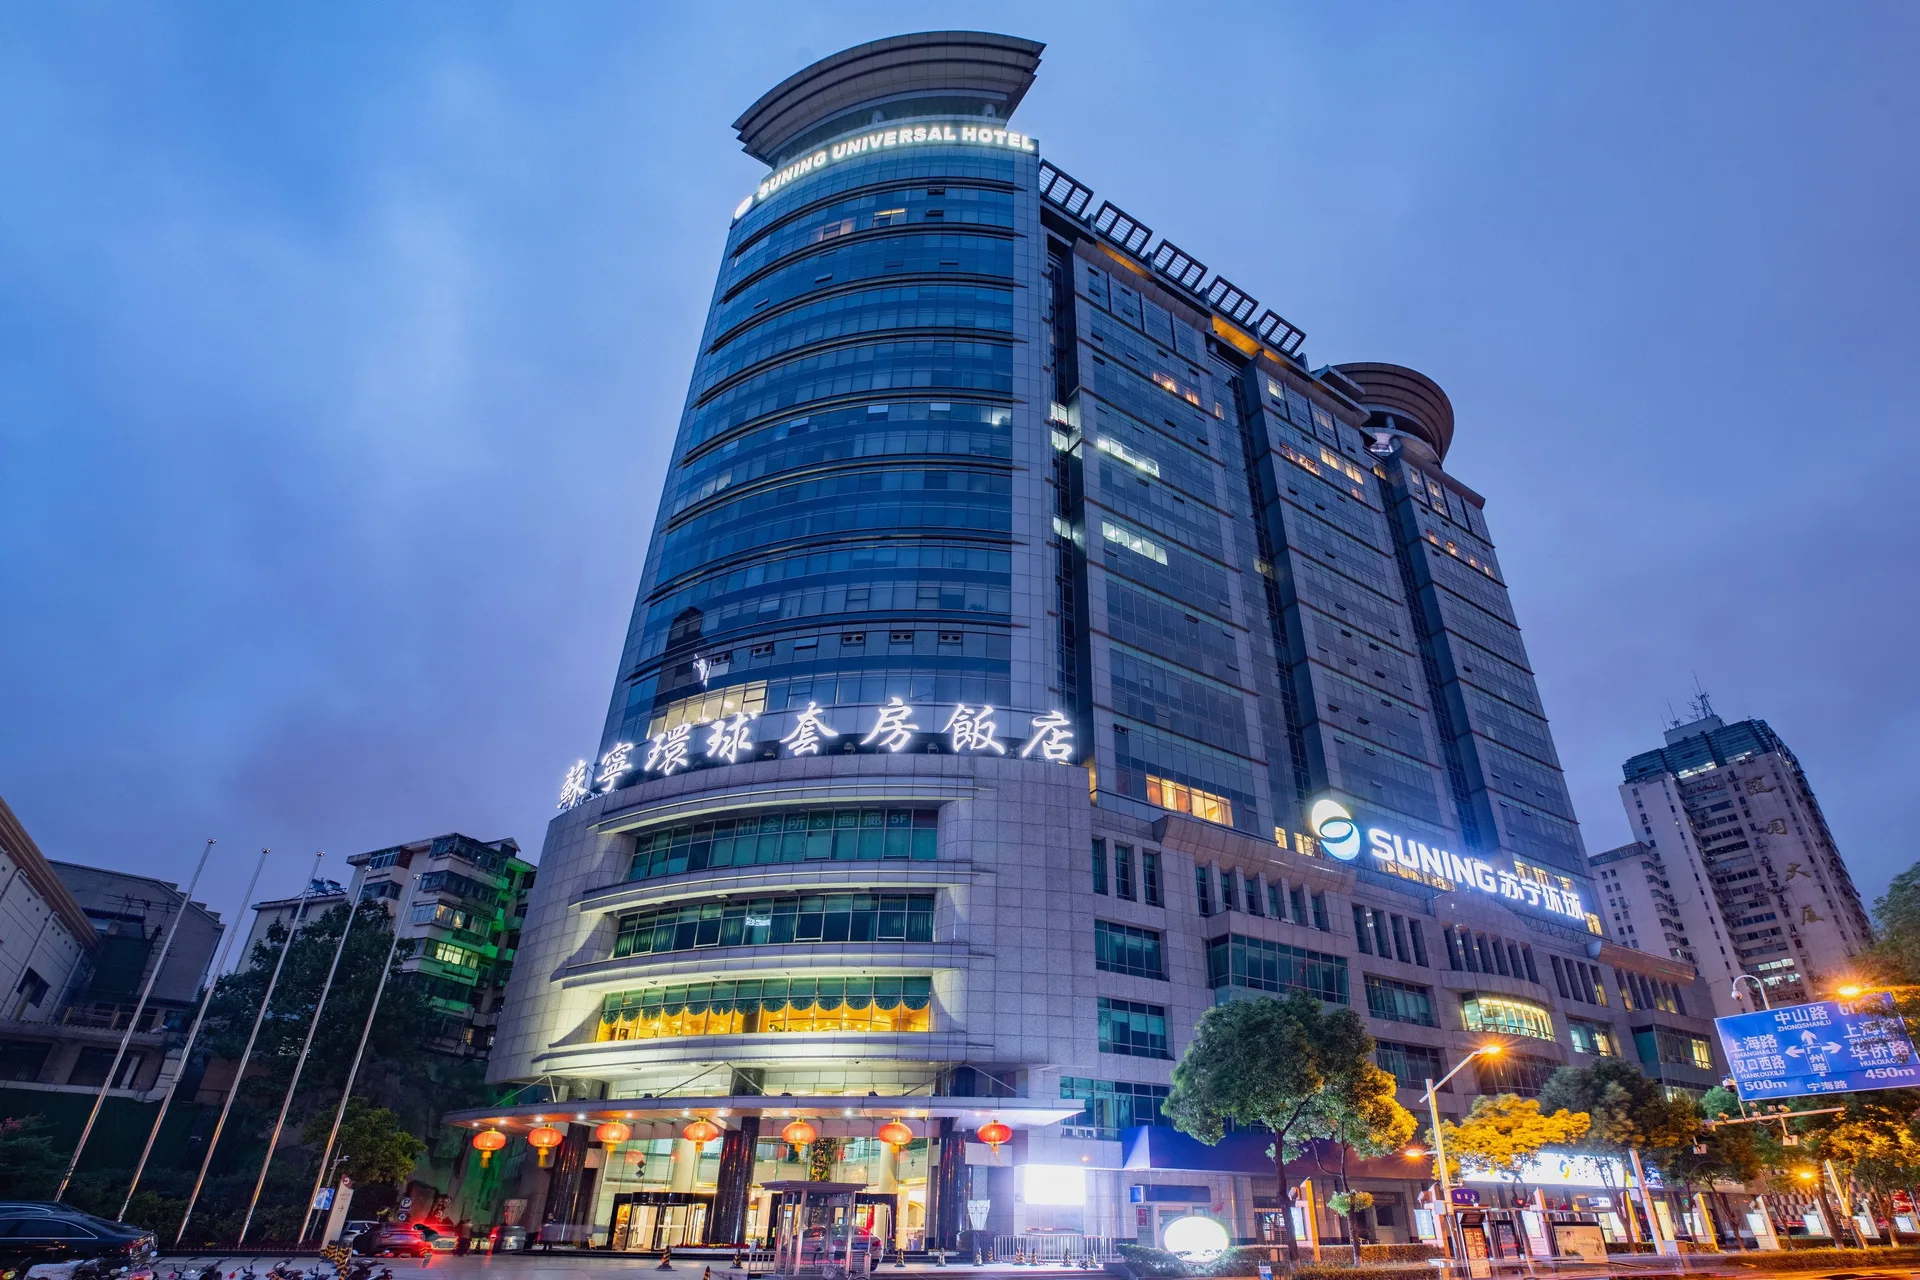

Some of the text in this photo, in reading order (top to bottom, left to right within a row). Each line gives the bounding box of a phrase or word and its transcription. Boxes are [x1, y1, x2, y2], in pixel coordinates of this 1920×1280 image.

[757, 125, 1035, 199] SUNING UNIVERSAL HOTEL
[557, 697, 1076, 809] 蘇寧環球套房飯店
[1368, 827, 1585, 920] SUNING 苏宁环球
[1774, 1005, 1829, 1025] 中山路
[1777, 1019, 1832, 1032] ZHONGSHANLU
[1730, 1034, 1778, 1052] 上海路
[1849, 1040, 1910, 1060] 华侨路
[1734, 1048, 1777, 1059] SHANGHAILU
[1806, 1045, 1827, 1072] 广州路
[1733, 1055, 1786, 1074] 汉口西路
[1864, 1066, 1916, 1080] 450m
[1740, 1069, 1786, 1080] HANKOUXILU
[1744, 1079, 1788, 1091] 500m
[1806, 1080, 1848, 1092] 宁海路
